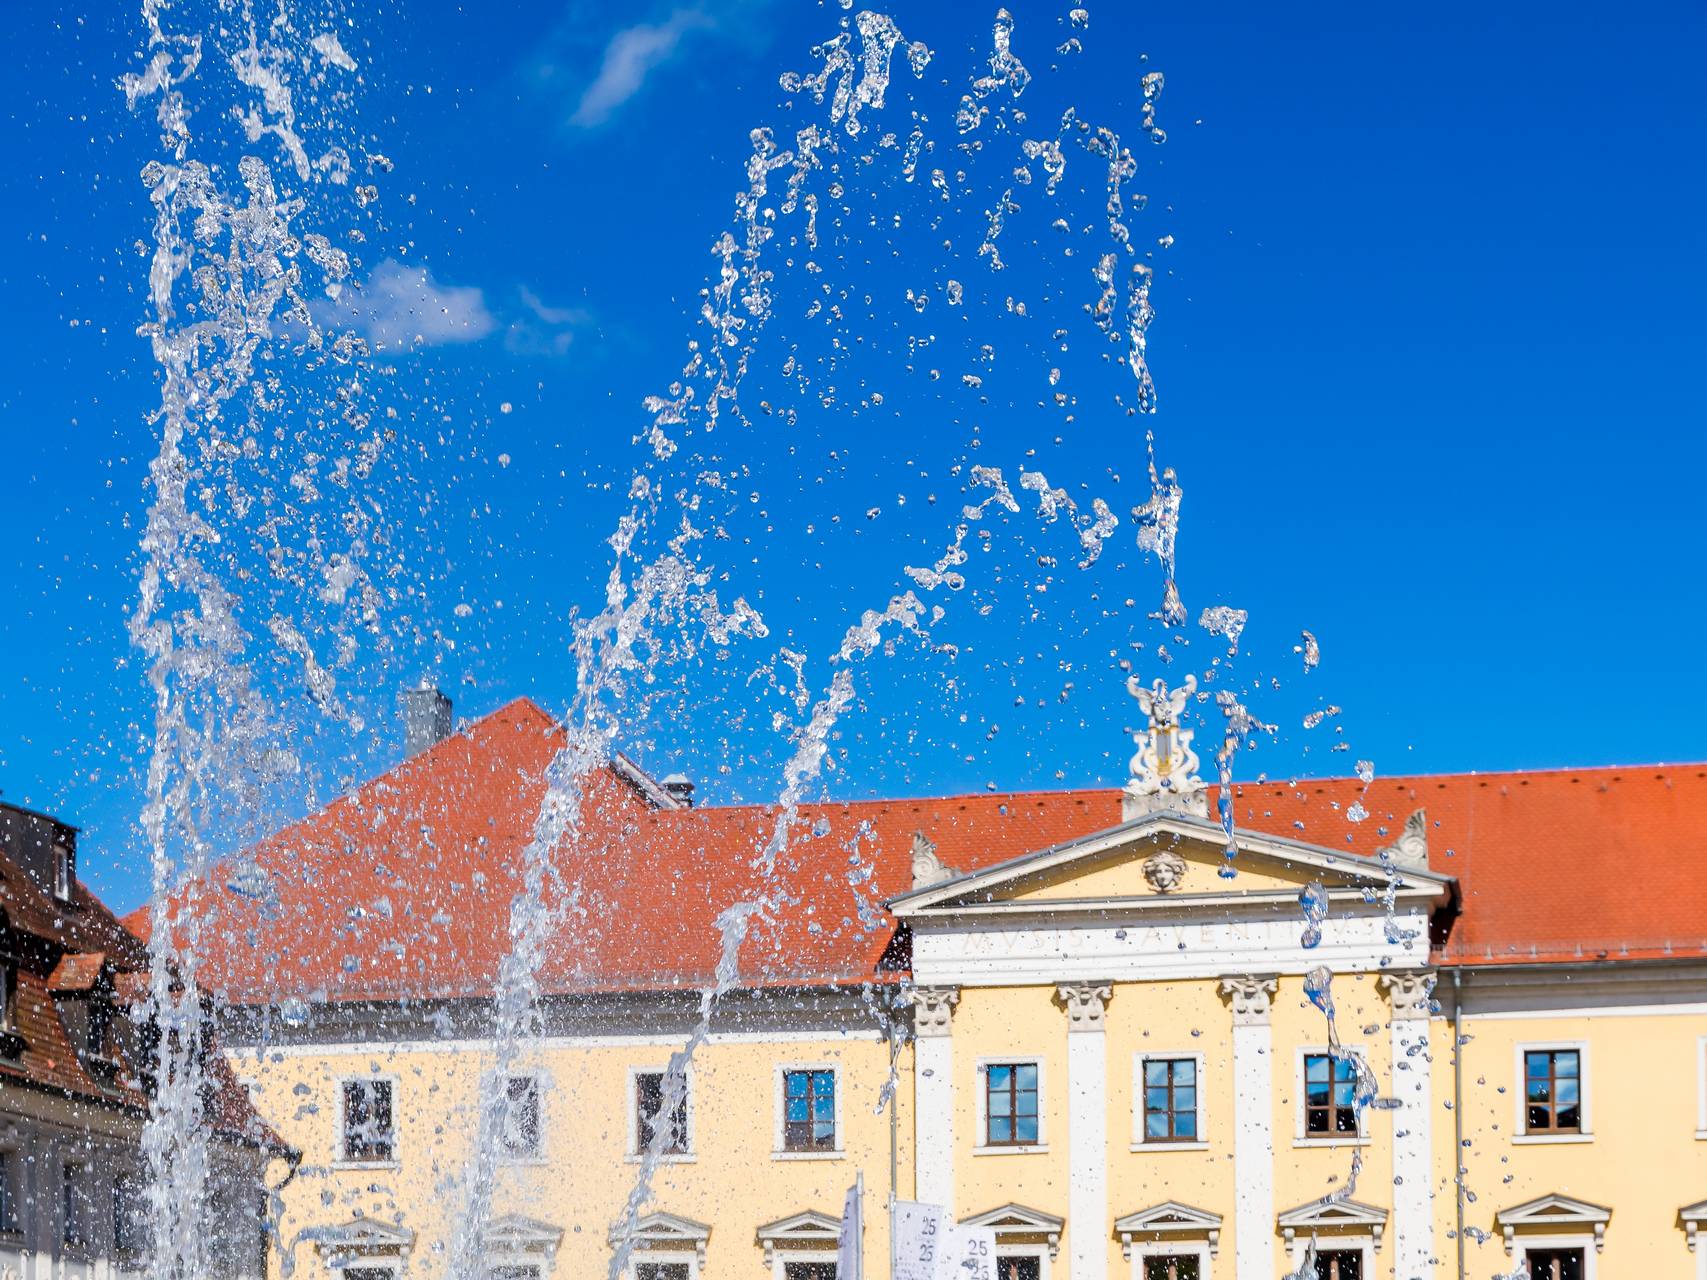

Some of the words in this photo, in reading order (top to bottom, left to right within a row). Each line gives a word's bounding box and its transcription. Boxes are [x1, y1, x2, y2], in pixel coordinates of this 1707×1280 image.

[921, 1216, 936, 1236] 25
[919, 1243, 934, 1262] 25
[968, 1239, 988, 1256] 25
[970, 1263, 990, 1280] 25
